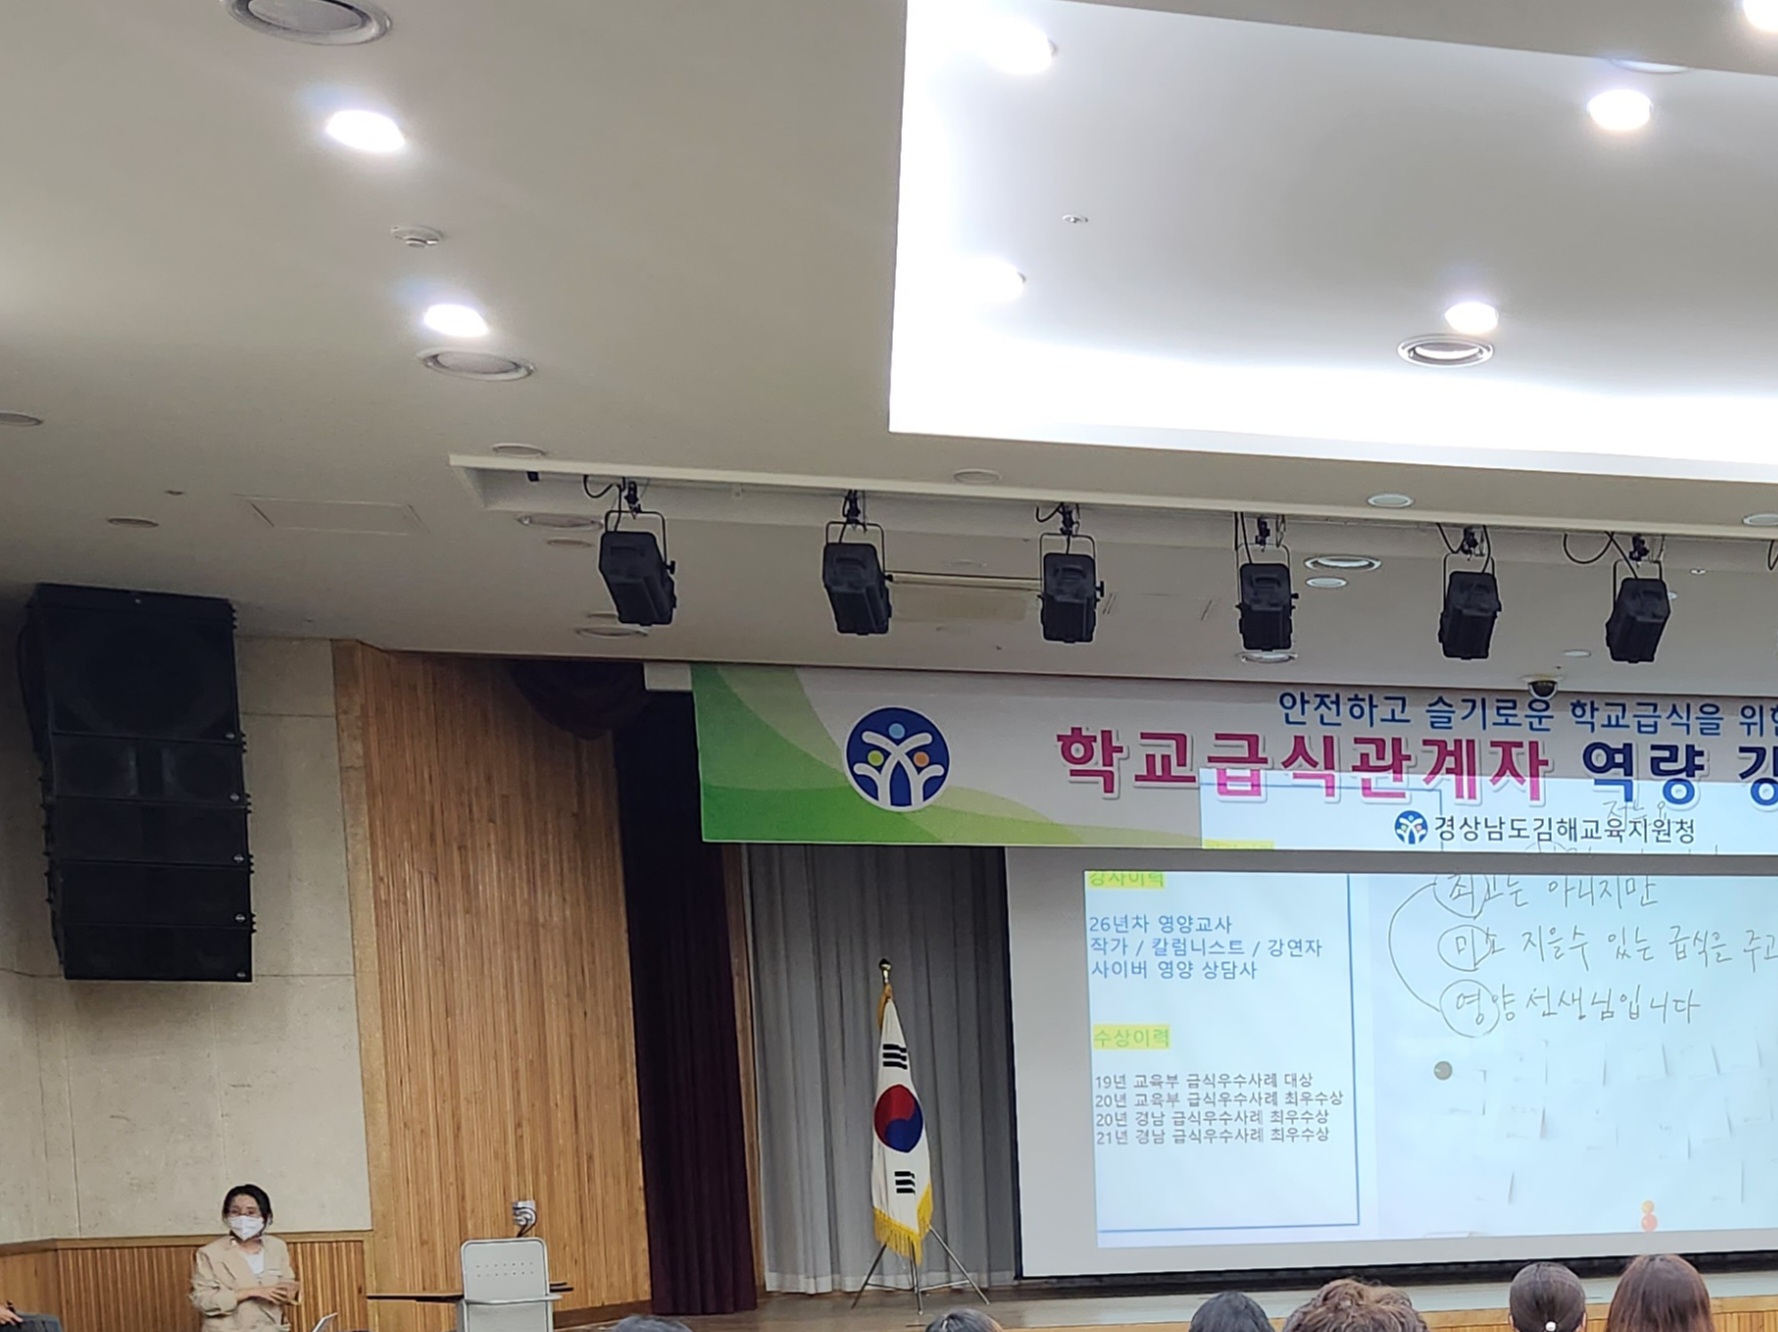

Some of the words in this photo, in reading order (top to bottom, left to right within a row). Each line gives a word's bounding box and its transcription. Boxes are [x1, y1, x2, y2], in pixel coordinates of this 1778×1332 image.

[1279, 692, 1410, 727] 안전하고
[1426, 696, 1554, 731] 슬기로운
[1570, 700, 1724, 736] 학교급식을
[1056, 727, 1549, 801] 학교급식관계자
[1582, 741, 1705, 807] 역량
[1435, 815, 1695, 845] 경상남도김해교육지원청
[1089, 914, 1150, 934] 26년차
[1158, 915, 1232, 934] 영양교사
[1090, 937, 1129, 956] 작가
[1152, 937, 1245, 957] 칼럼니스트
[1268, 938, 1323, 957] 강연자
[1607, 926, 1655, 962] 있는
[1092, 960, 1148, 980] 사이버
[1158, 960, 1194, 980] 영양
[1202, 960, 1258, 980] 상담사
[1094, 1028, 1169, 1048] 수상이력
[1096, 1074, 1126, 1090] 19년
[1133, 1073, 1179, 1090] 교육부
[1186, 1073, 1278, 1089] 급식우수사례
[1284, 1072, 1313, 1088] 대상
[1095, 1092, 1127, 1109] 20년
[1134, 1092, 1180, 1108] 교육부
[1187, 1091, 1278, 1108] 급식우수사례
[1285, 1090, 1344, 1107] 최우수상
[1096, 1111, 1128, 1128] 20년
[1135, 1111, 1166, 1127] 경남
[1172, 1109, 1263, 1127] 급식우수사례
[1270, 1109, 1330, 1126] 최우수상
[1096, 1129, 1129, 1146] 21년
[1136, 1128, 1166, 1145] 경남
[1172, 1127, 1264, 1145] 급식우수사례
[1270, 1126, 1330, 1143] 최우수상
